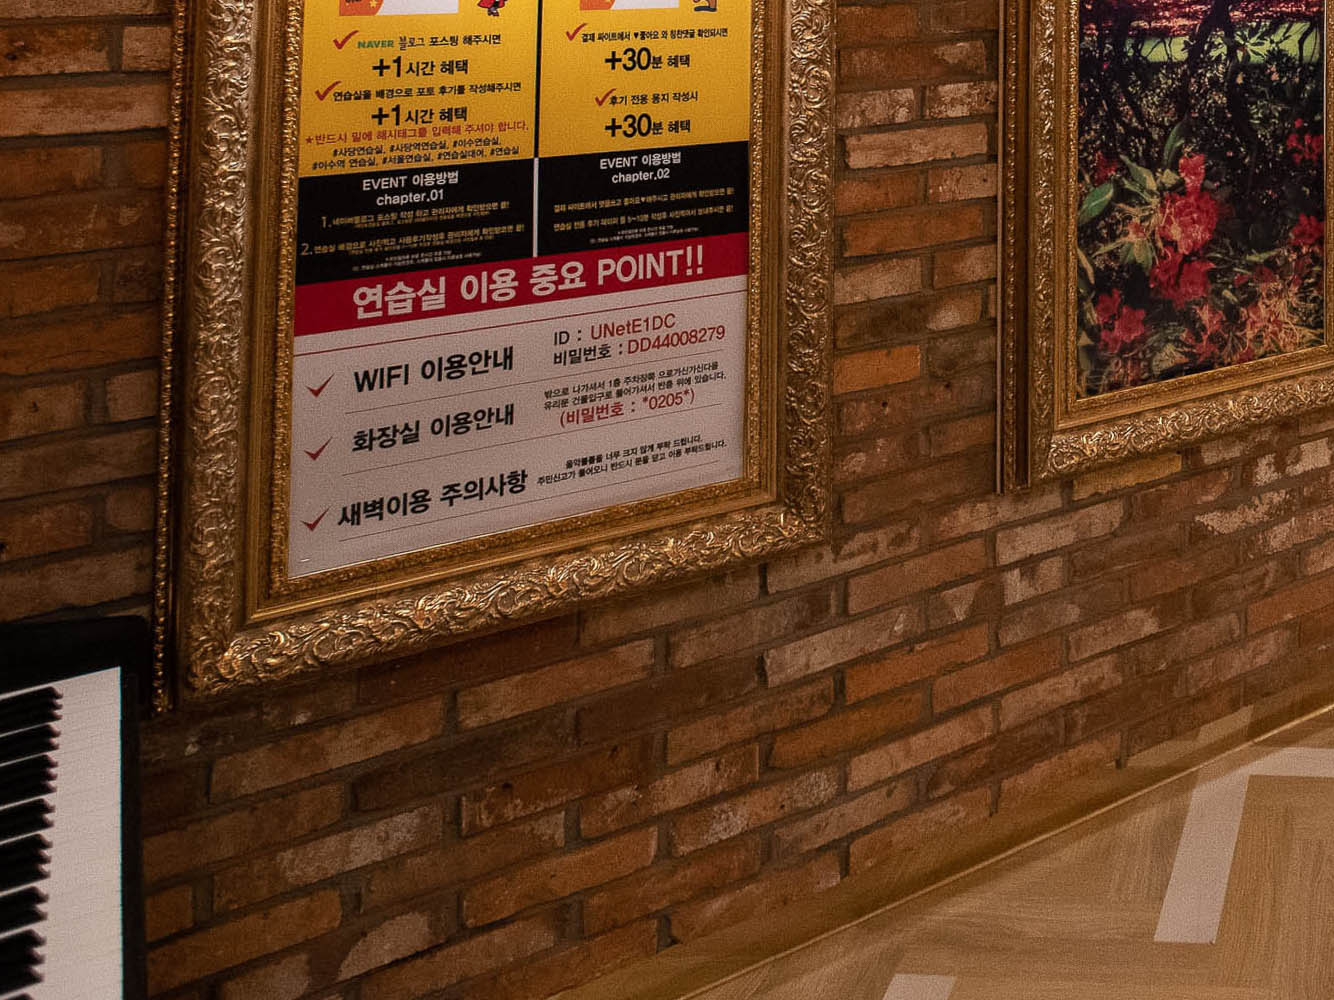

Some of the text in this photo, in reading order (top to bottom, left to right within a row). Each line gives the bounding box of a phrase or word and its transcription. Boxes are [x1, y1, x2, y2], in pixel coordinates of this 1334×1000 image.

[357, 34, 501, 50] NAVER 블로그 포스팅 해주시면
[440, 59, 469, 75] 혜택
[667, 54, 691, 68] 혜택
[333, 82, 521, 102] 연습실을 배경으로 포토 후기를 작성해주시면
[609, 94, 628, 106] 후기
[672, 91, 698, 102] 작성시
[439, 106, 467, 123] 혜택
[668, 119, 691, 134] 혜택
[600, 152, 681, 170] EVENT 이용방법
[362, 171, 460, 191] EVENT 이용방법
[612, 168, 671, 184] chapter.02
[376, 189, 444, 207] chapter.01
[352, 244, 703, 320] 연습실 이용 중요 POINT!!
[554, 313, 676, 346] ID UNetE1DC
[553, 325, 726, 366] 비밀번호 DD44008279
[354, 346, 514, 392] WIFI 이용안내
[560, 401, 624, 428] (비밀번호
[352, 403, 515, 452] 화장실 이용안내
[338, 469, 528, 526] 새벽이용 주의사항
